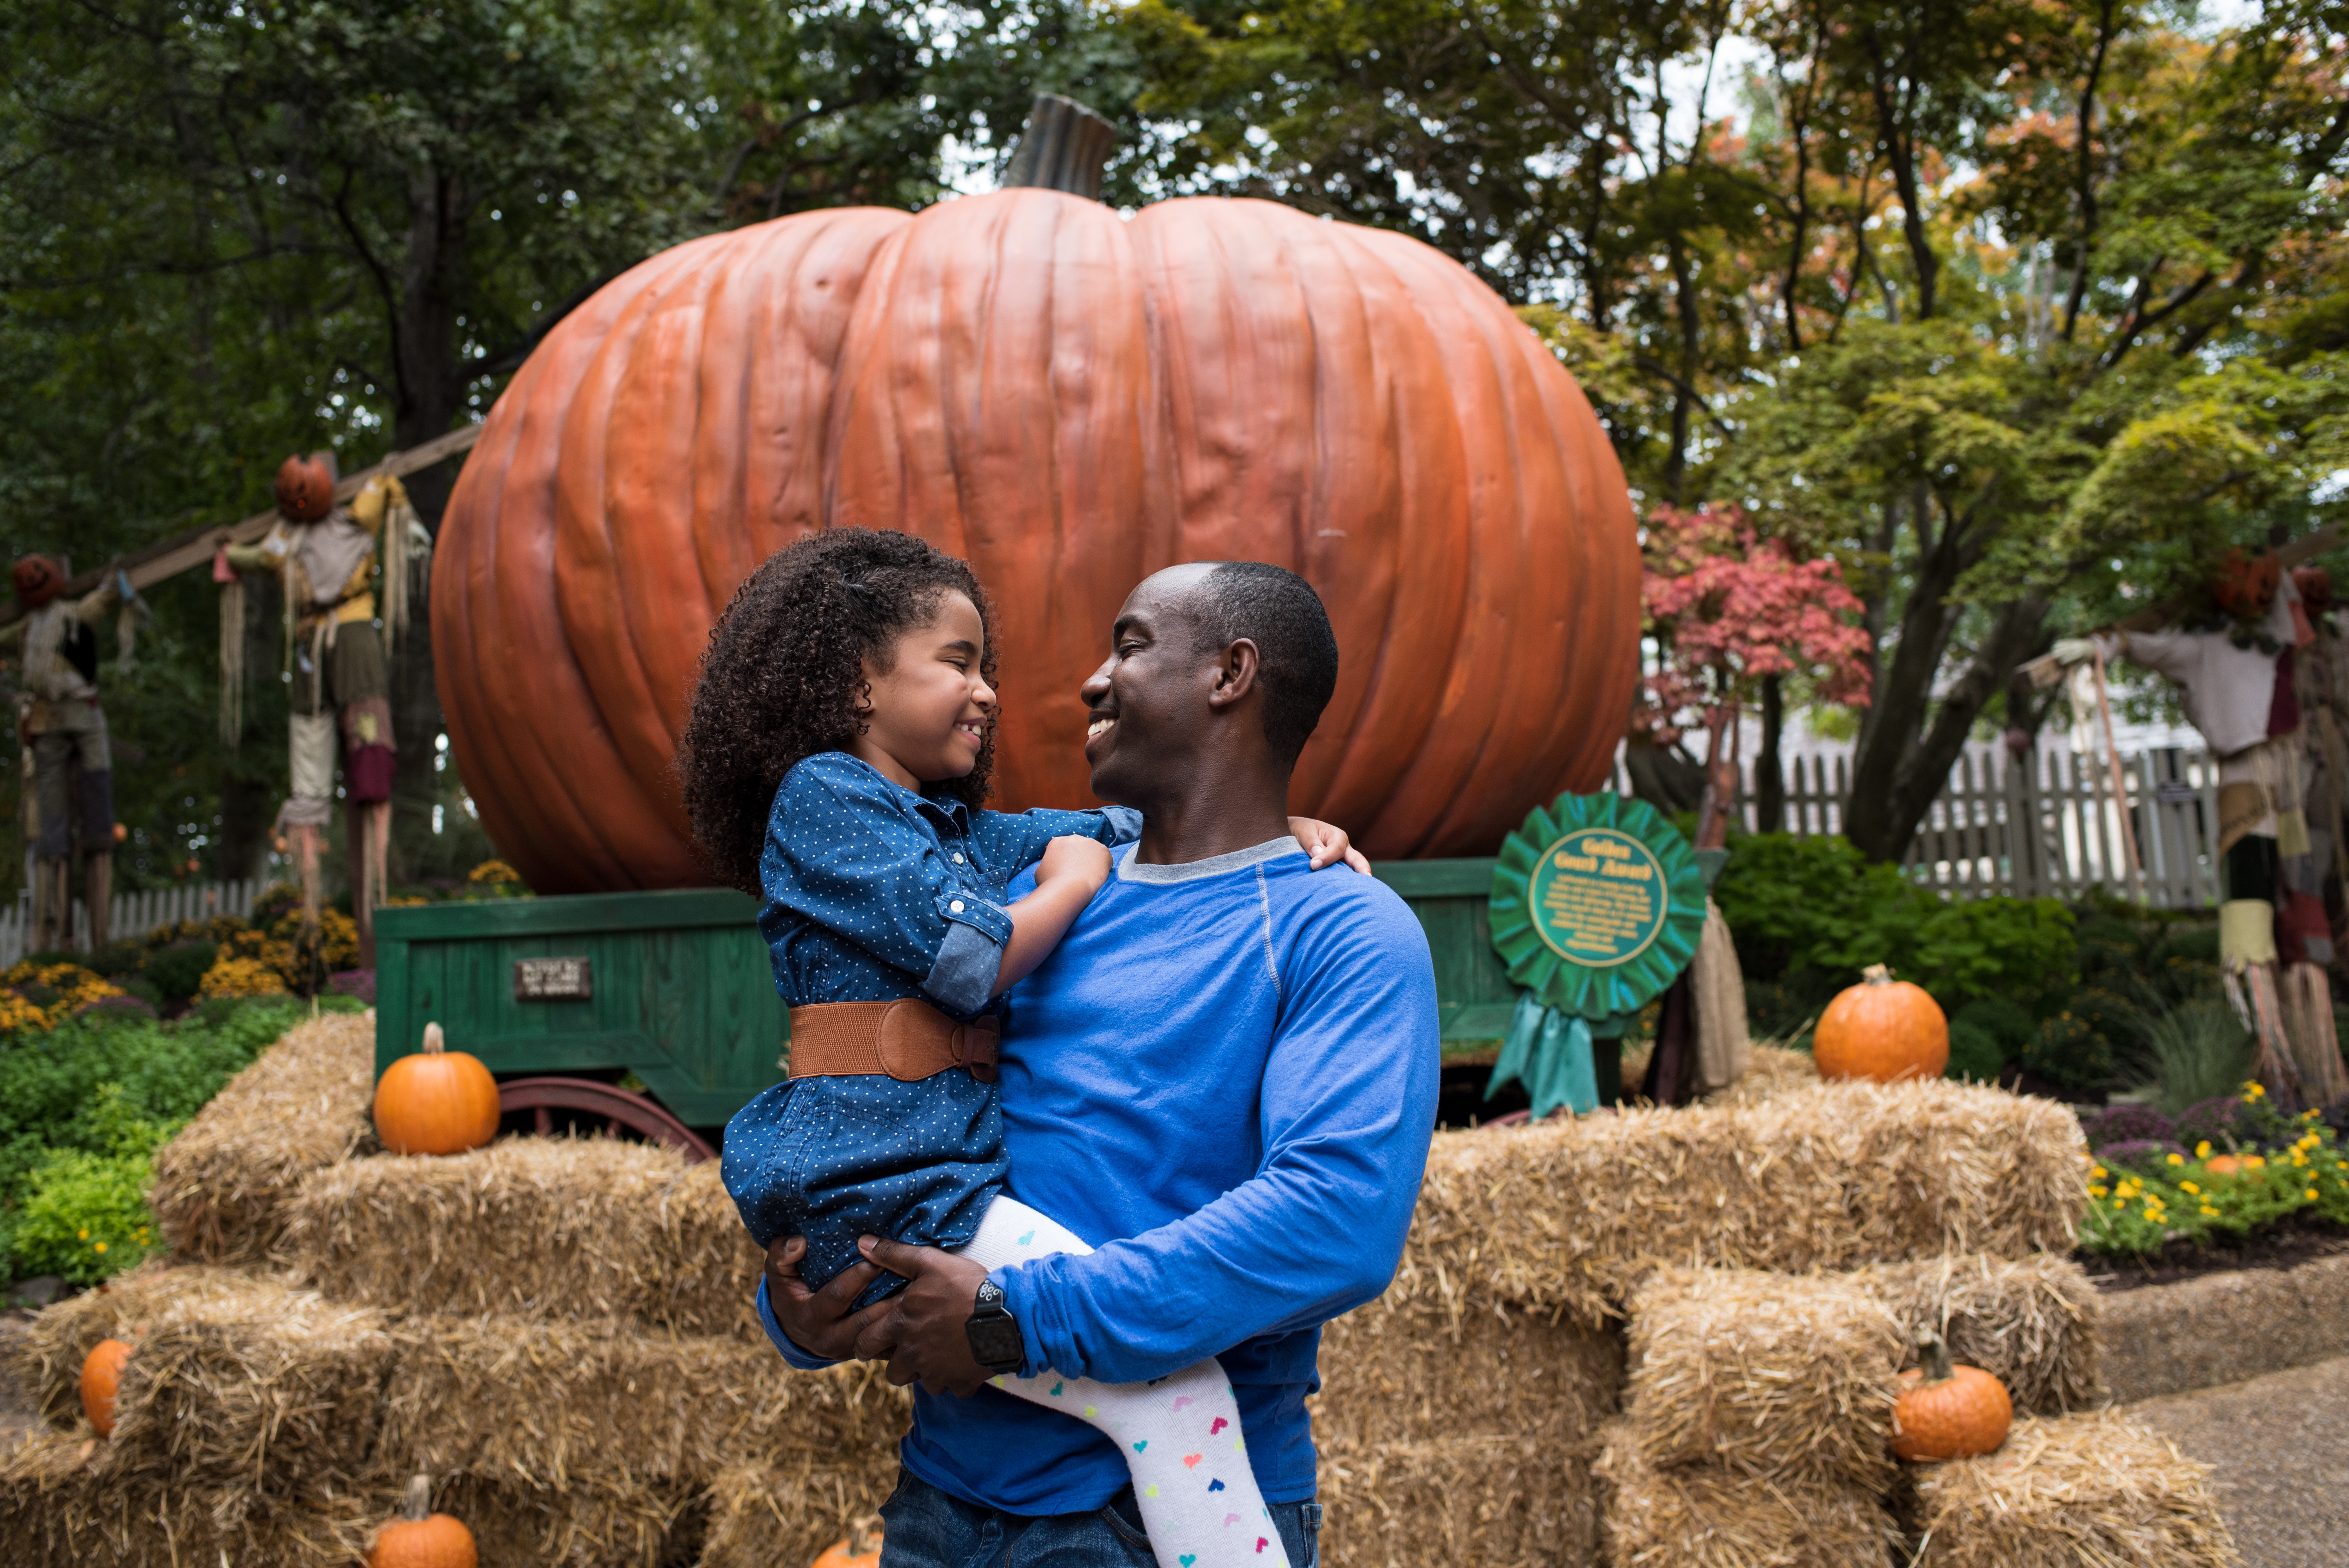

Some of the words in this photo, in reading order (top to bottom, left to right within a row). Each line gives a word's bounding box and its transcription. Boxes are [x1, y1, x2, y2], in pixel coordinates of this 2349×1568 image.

[1582, 838, 1631, 859] Golden
[1554, 852, 1598, 872] Gourd
[1601, 859, 1652, 881] Award
